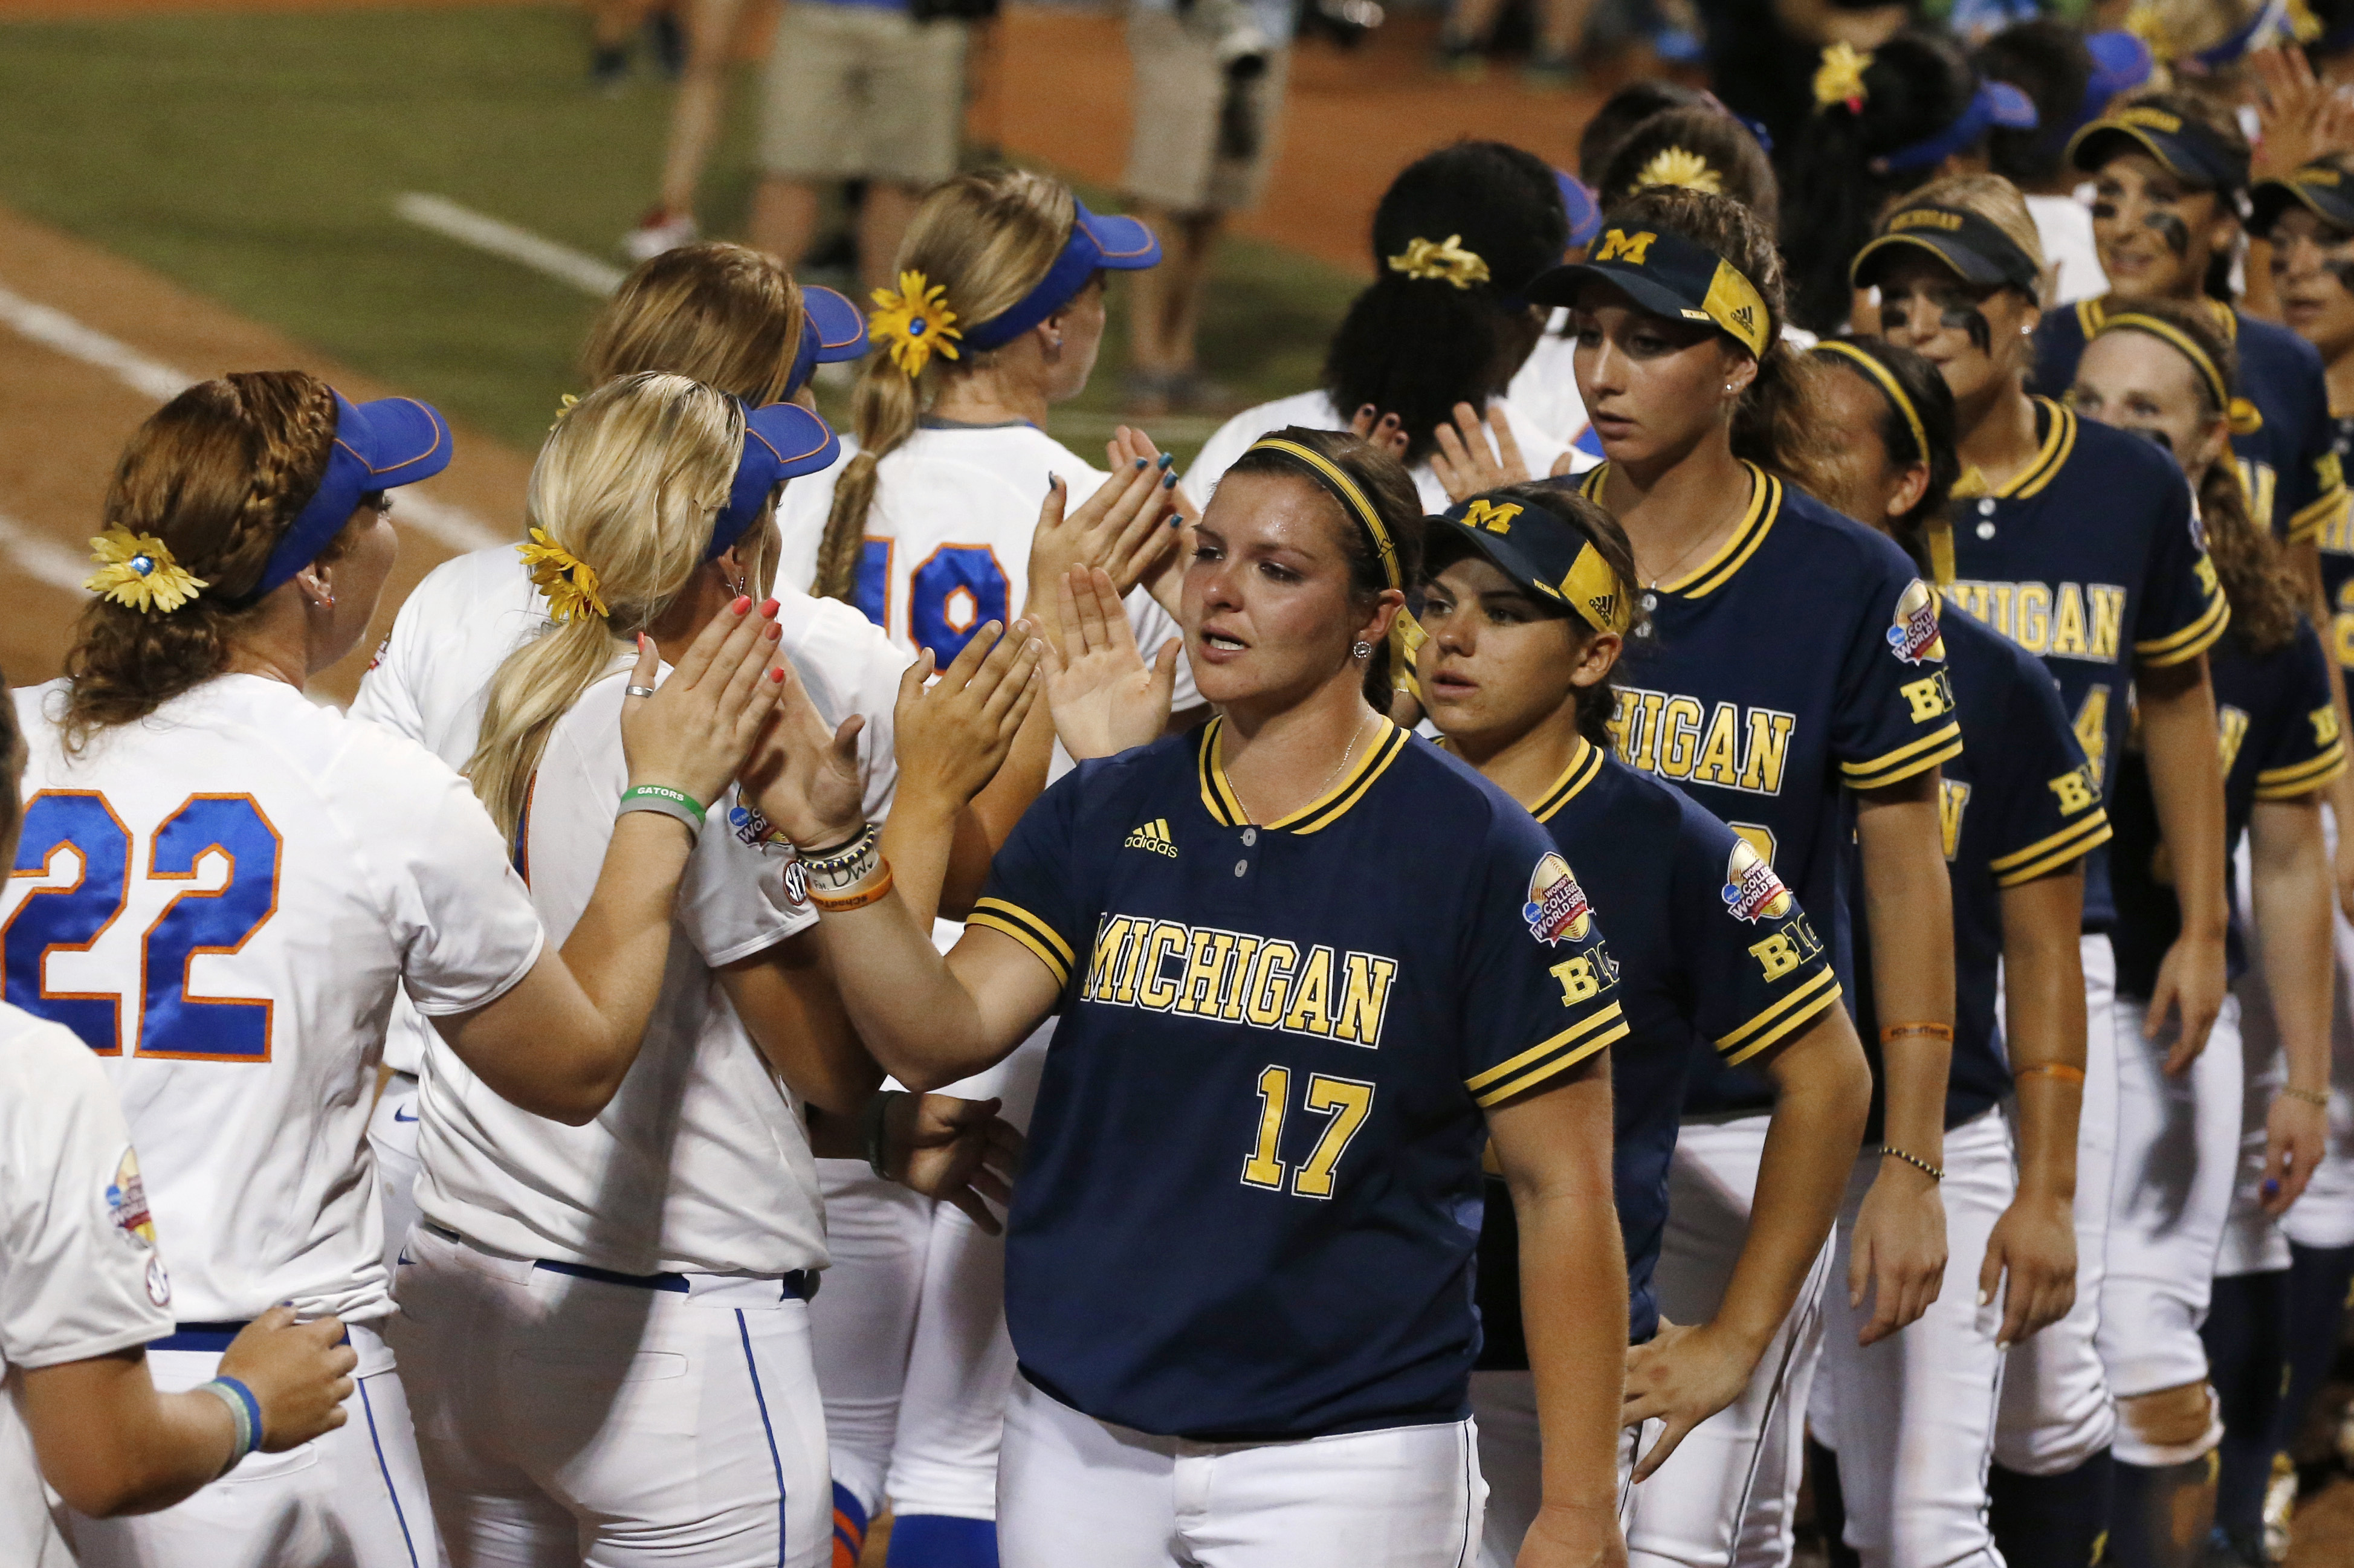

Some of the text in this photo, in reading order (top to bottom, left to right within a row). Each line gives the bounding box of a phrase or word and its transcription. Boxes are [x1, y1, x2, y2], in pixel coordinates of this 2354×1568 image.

[1596, 228, 1658, 265] M
[1460, 499, 1524, 535] M
[637, 787, 685, 801] GATORS
[1124, 834, 1178, 858] adidas
[1543, 882, 1578, 915] COLLEGE
[1733, 882, 1769, 918] WORLD
[0, 788, 283, 1063] 22
[1534, 902, 1570, 938] WORLD
[1080, 911, 1398, 1050] MICHIGAN
[1240, 1063, 1376, 1200] 17
